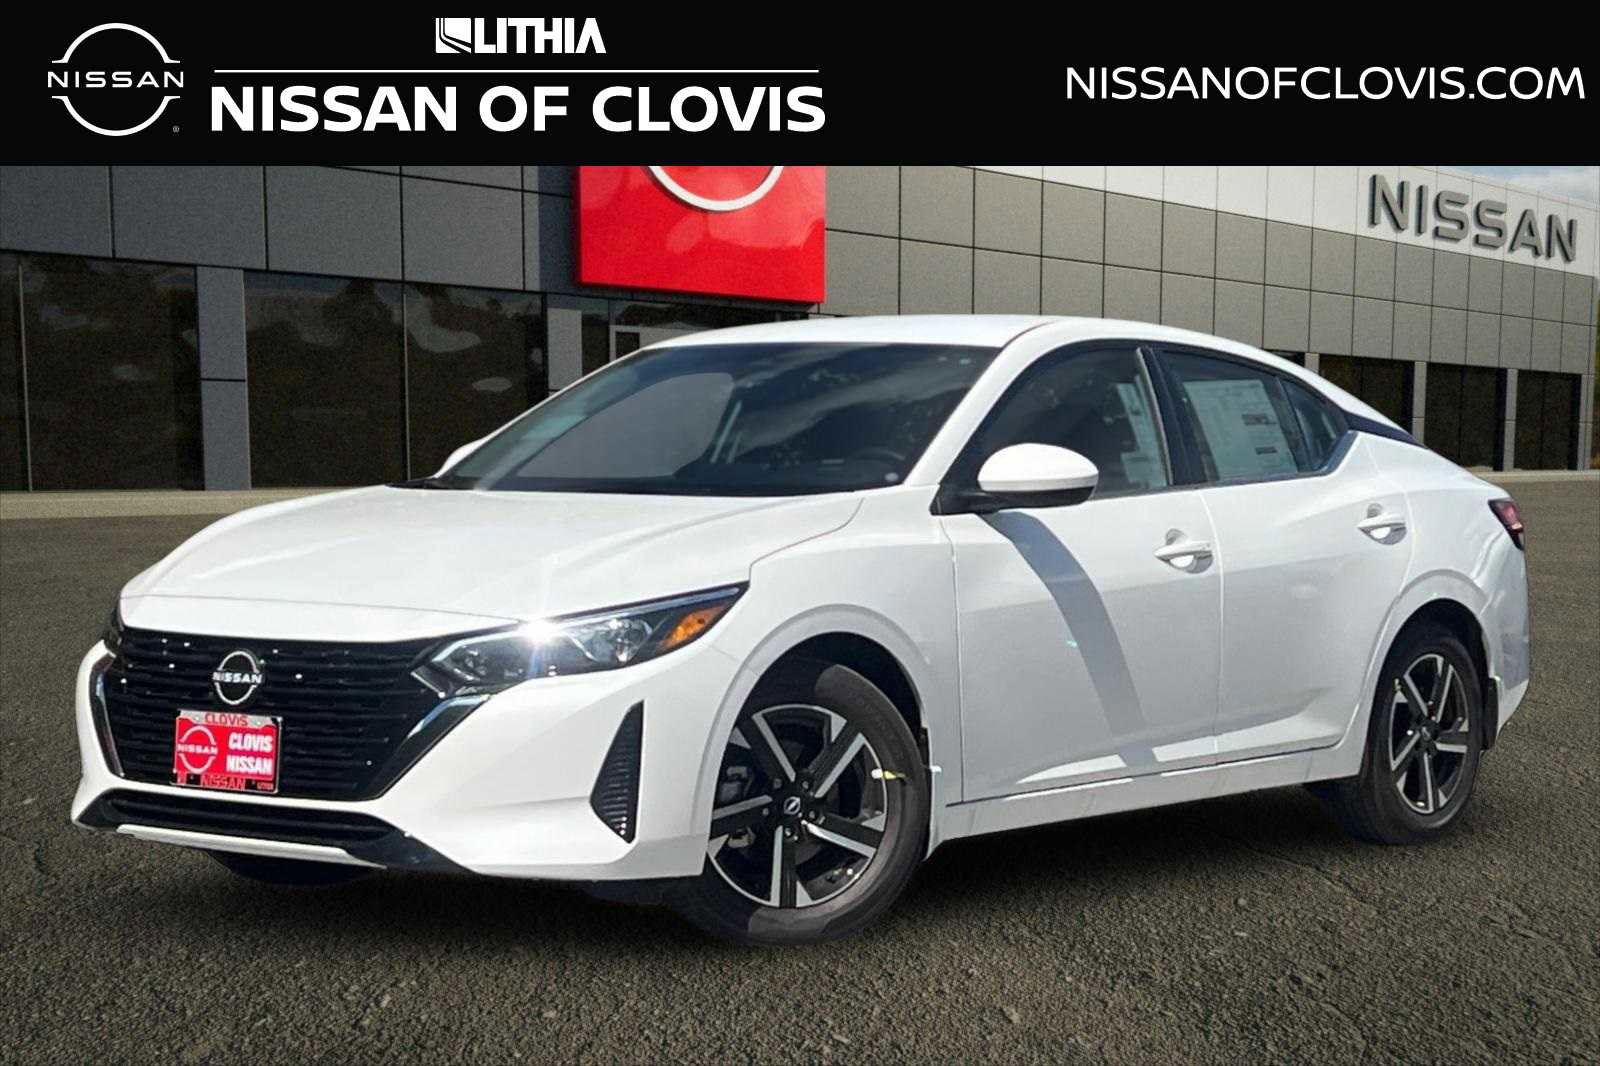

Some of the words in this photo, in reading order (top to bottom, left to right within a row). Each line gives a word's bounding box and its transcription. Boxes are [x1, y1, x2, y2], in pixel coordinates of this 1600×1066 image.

[1368, 174, 1578, 263] NISSAN
[212, 671, 262, 684] NISSAN
[205, 713, 249, 726] CLOVIS
[177, 744, 218, 753] NISSAN
[228, 732, 273, 752] CLOVIS
[226, 755, 273, 774] NISSAN
[200, 774, 245, 790] NISSAN
